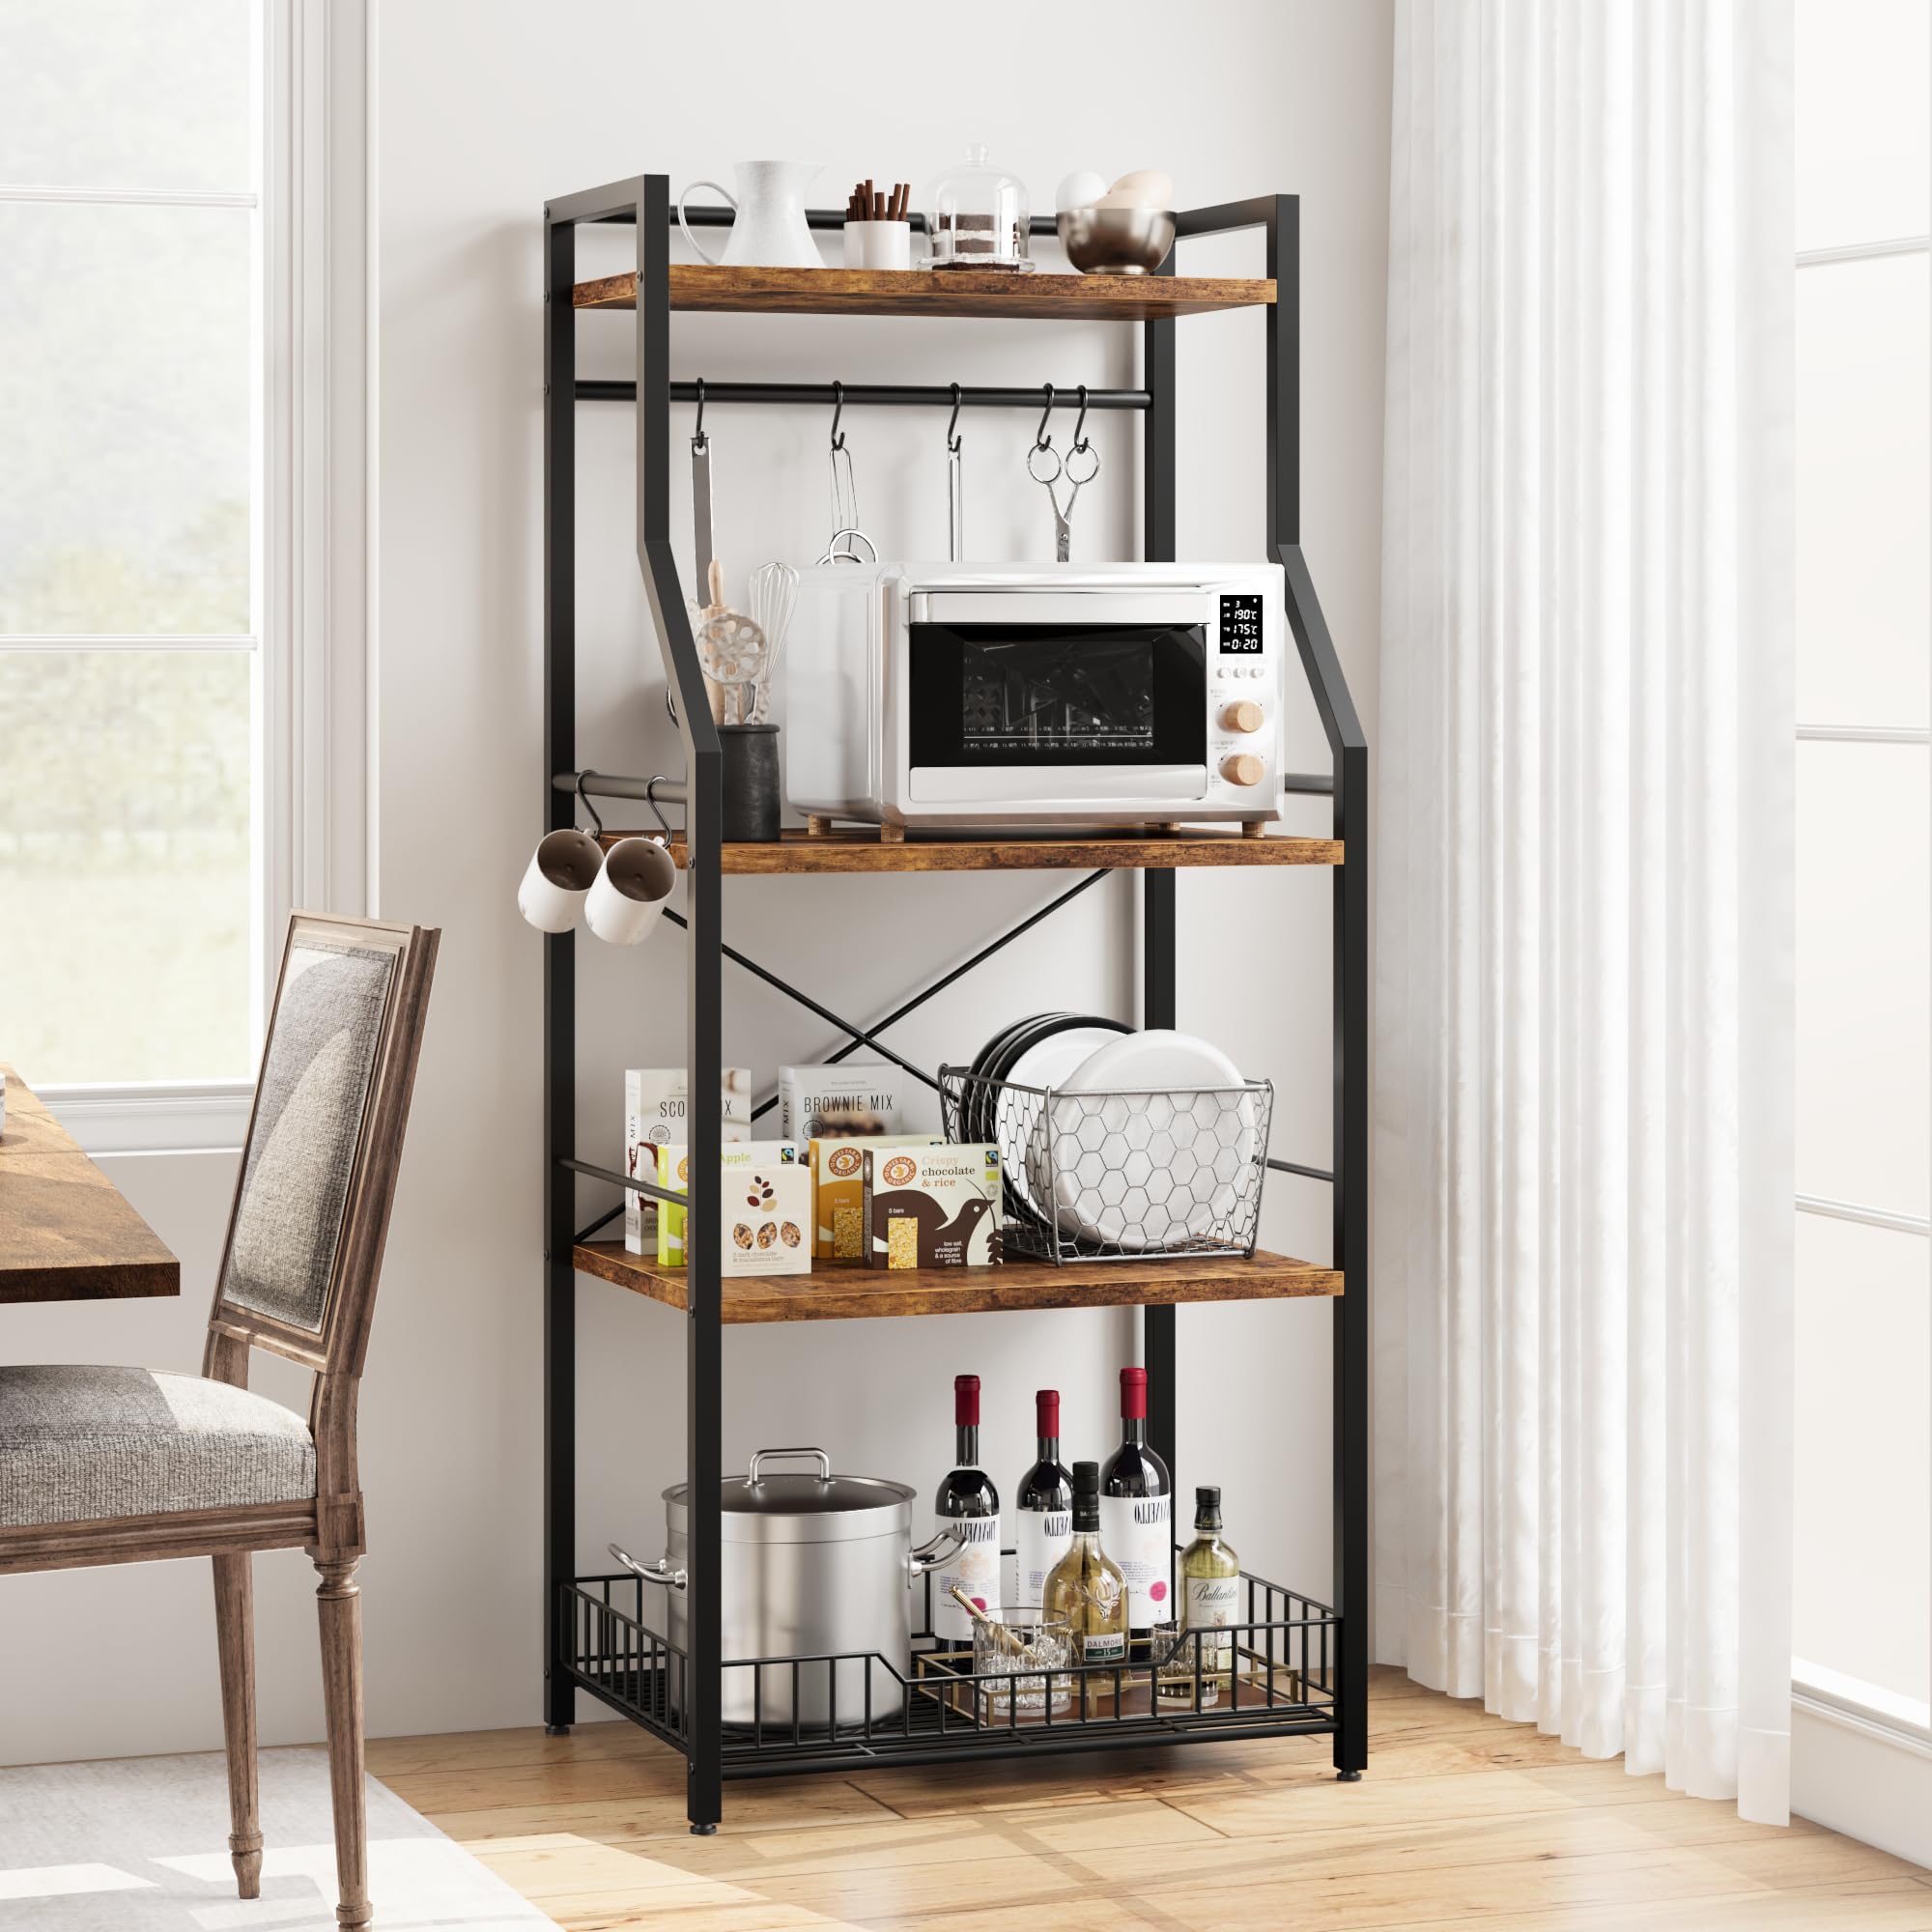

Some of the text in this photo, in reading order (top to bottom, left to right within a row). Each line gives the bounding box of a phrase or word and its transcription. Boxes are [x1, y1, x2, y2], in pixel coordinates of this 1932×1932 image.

[1236, 600, 1240, 609] 3
[660, 1100, 685, 1118] SCO
[804, 1094, 893, 1114] BROWNIE MIX
[922, 1156, 958, 1167] Crispy
[922, 1166, 976, 1177] chocolate
[934, 1178, 956, 1187] rice
[1087, 1638, 1122, 1648] DALMORE
